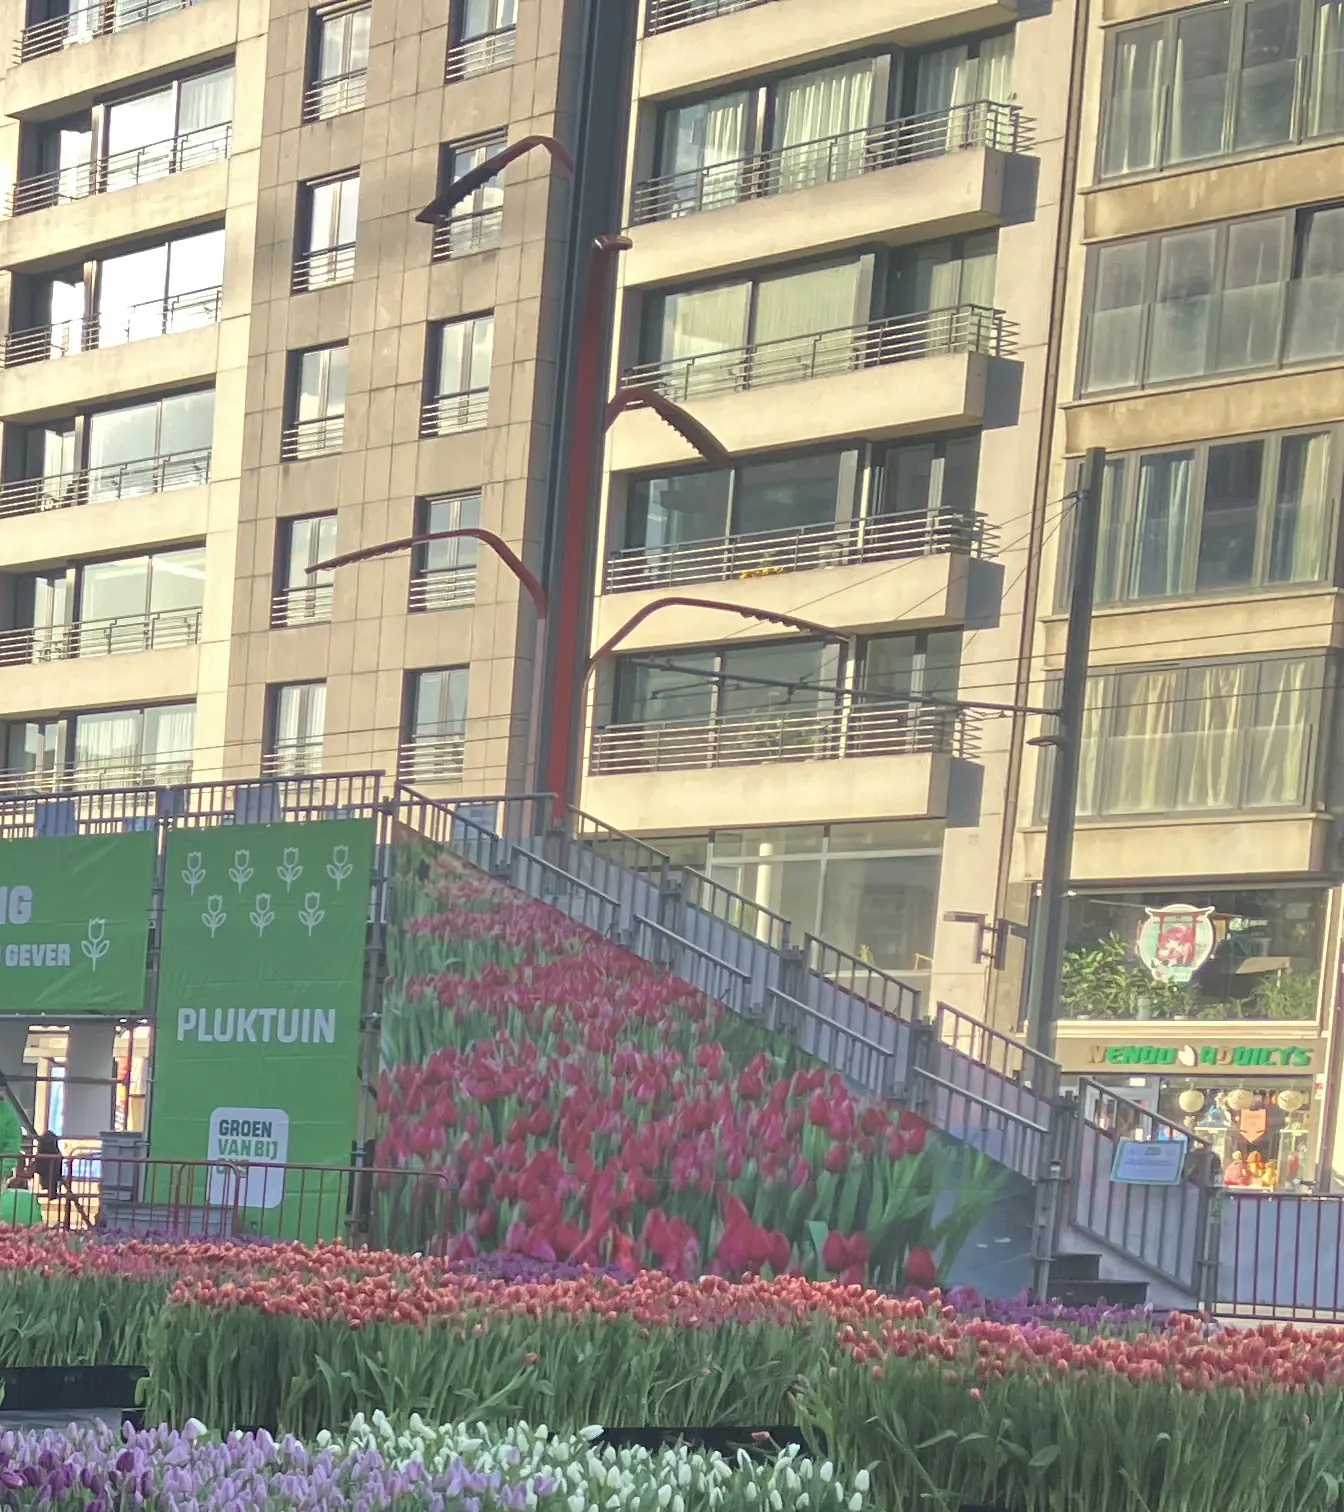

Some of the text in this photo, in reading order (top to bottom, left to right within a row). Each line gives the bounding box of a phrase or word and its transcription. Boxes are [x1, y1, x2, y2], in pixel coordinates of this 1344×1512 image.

[5, 943, 72, 967] GEVER
[177, 1007, 336, 1044] PLUKTUIN
[218, 1119, 273, 1138] GROEN
[217, 1138, 279, 1161] VAN BIJ
